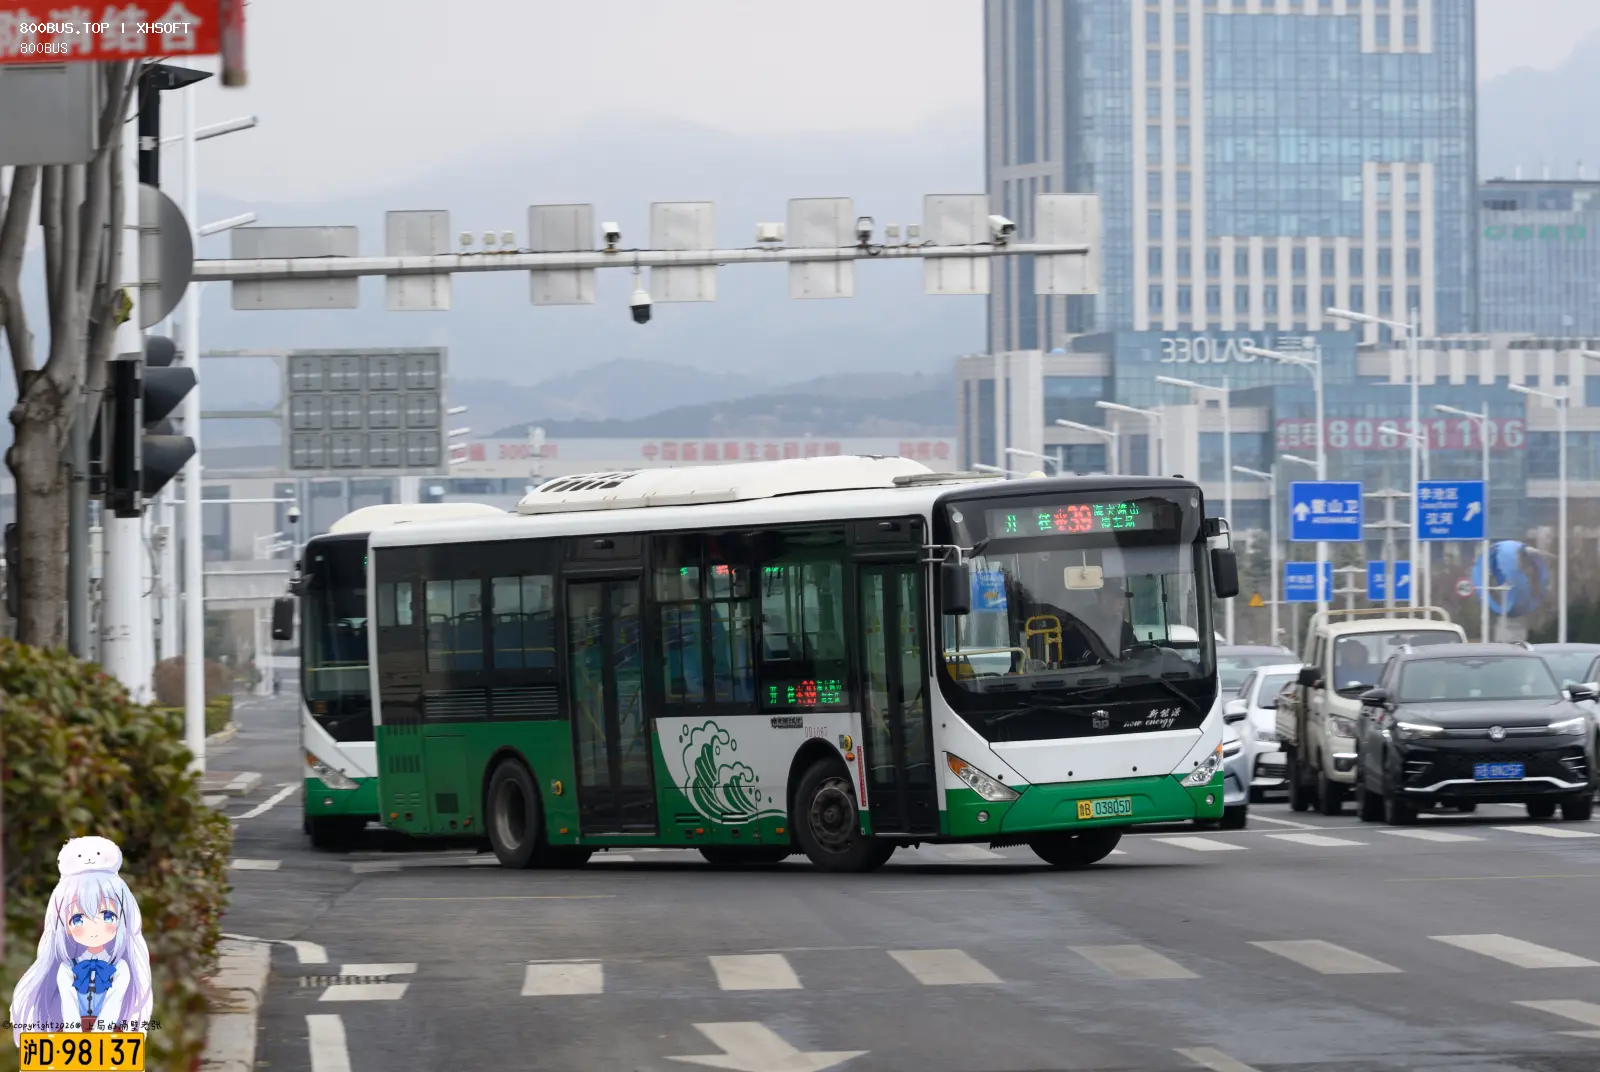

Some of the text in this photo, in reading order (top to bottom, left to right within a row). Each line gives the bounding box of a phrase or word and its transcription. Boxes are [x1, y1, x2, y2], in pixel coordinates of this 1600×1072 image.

[1147, 707, 1181, 719] 新能源
[1145, 717, 1175, 729] energy
